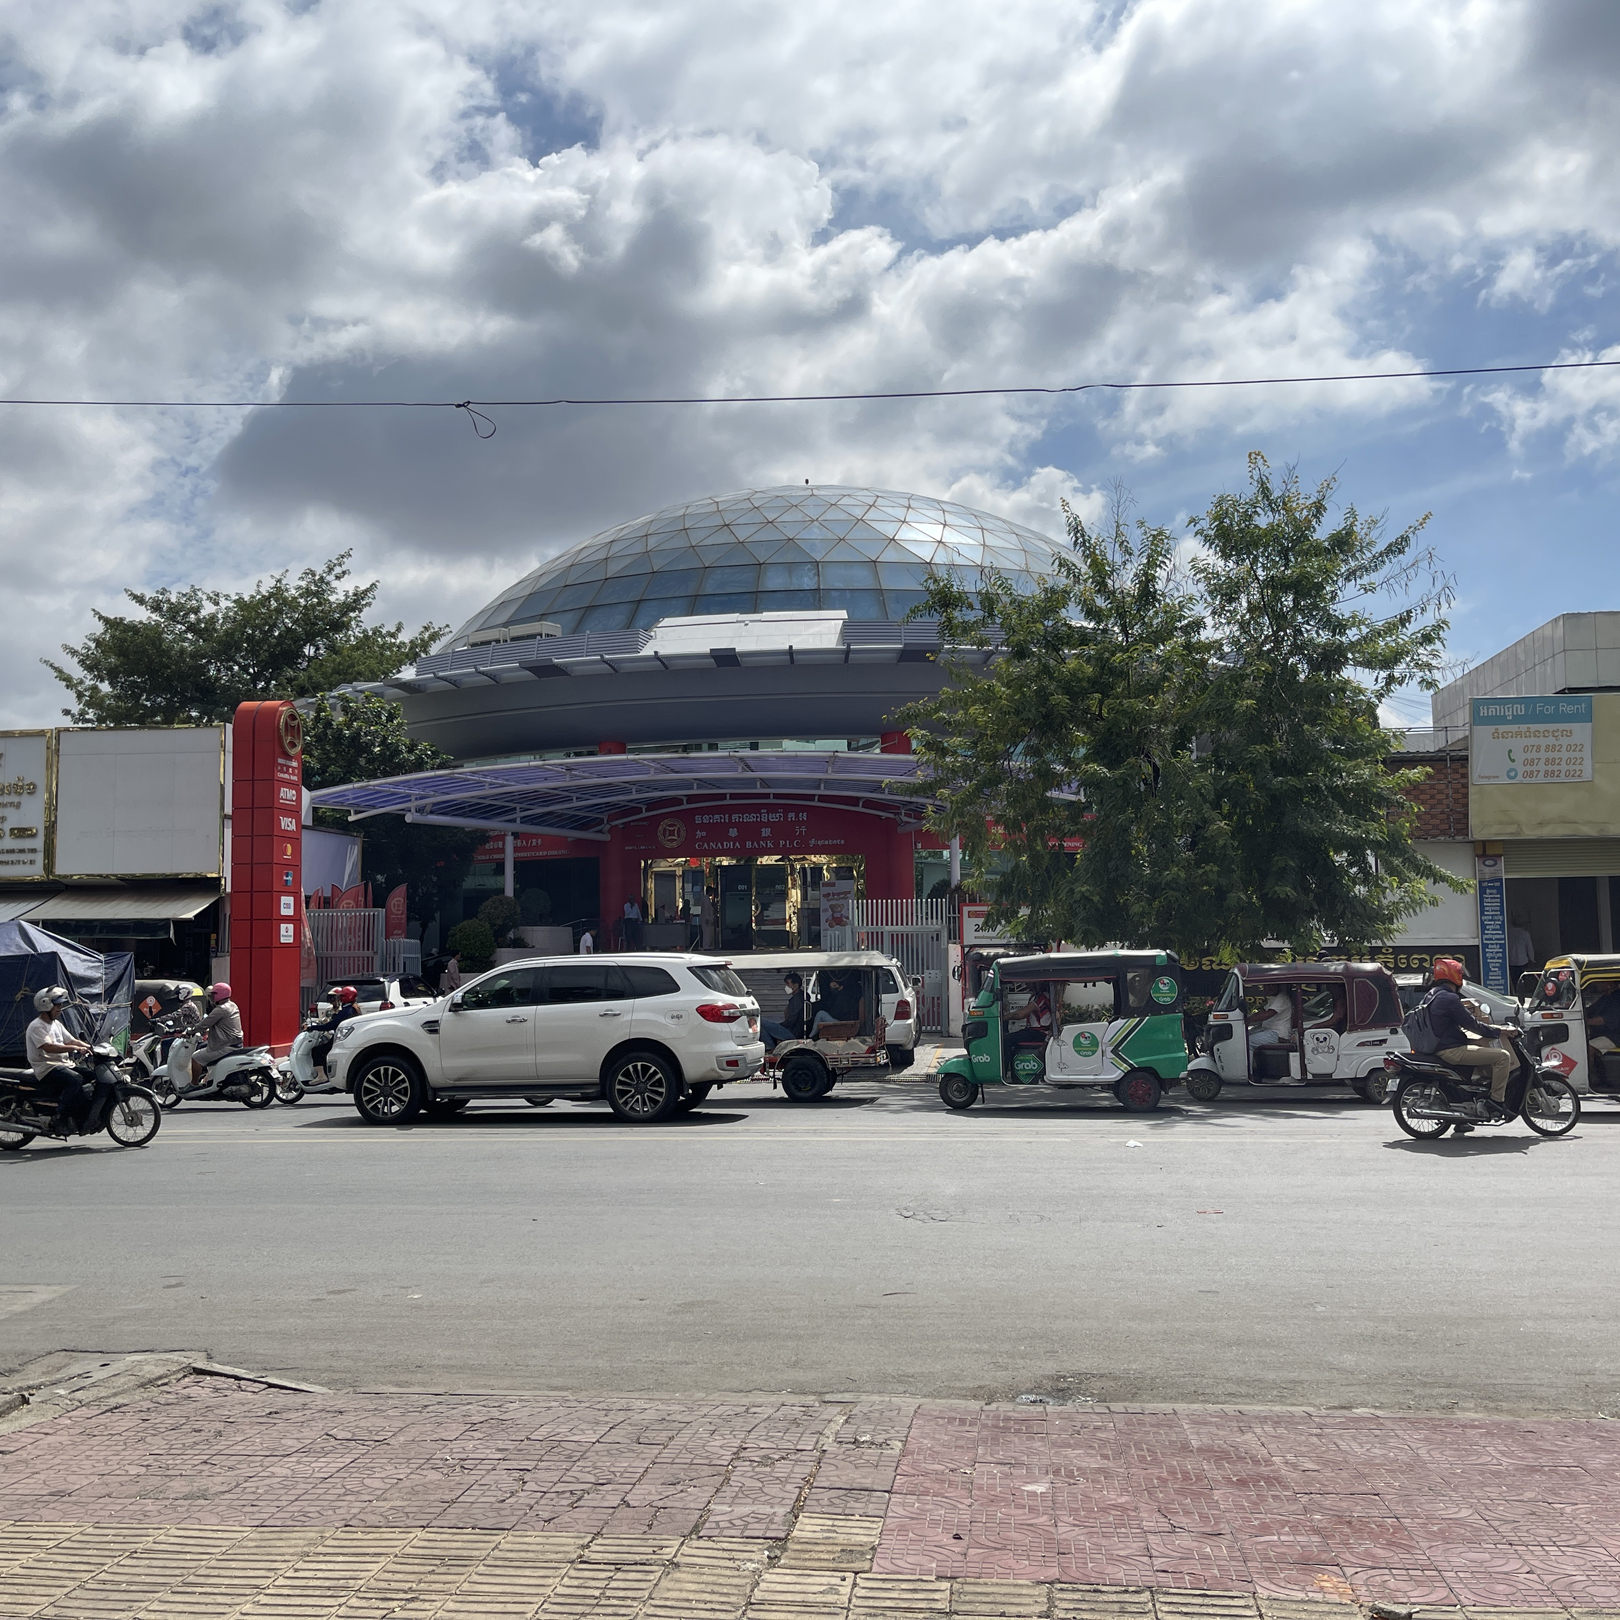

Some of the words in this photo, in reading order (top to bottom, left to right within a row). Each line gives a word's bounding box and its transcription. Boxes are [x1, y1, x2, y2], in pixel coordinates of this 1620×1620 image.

[1536, 703, 1555, 714] For
[1559, 703, 1586, 714] Rent
[1523, 744, 1541, 753] 078
[1544, 744, 1563, 753] 882
[1566, 743, 1585, 752] 022
[1522, 758, 1542, 767] 087
[1544, 757, 1563, 766] 882
[1565, 757, 1585, 766] 022
[1522, 770, 1541, 779] 087
[1543, 769, 1562, 778] 882
[1564, 769, 1584, 778] 022
[279, 816, 296, 832] VISA
[695, 841, 741, 850] CANADIA
[745, 840, 774, 849] BANK
[779, 839, 805, 848] PLC.
[971, 1053, 991, 1063] Grab
[1014, 1060, 1038, 1070] Grab
